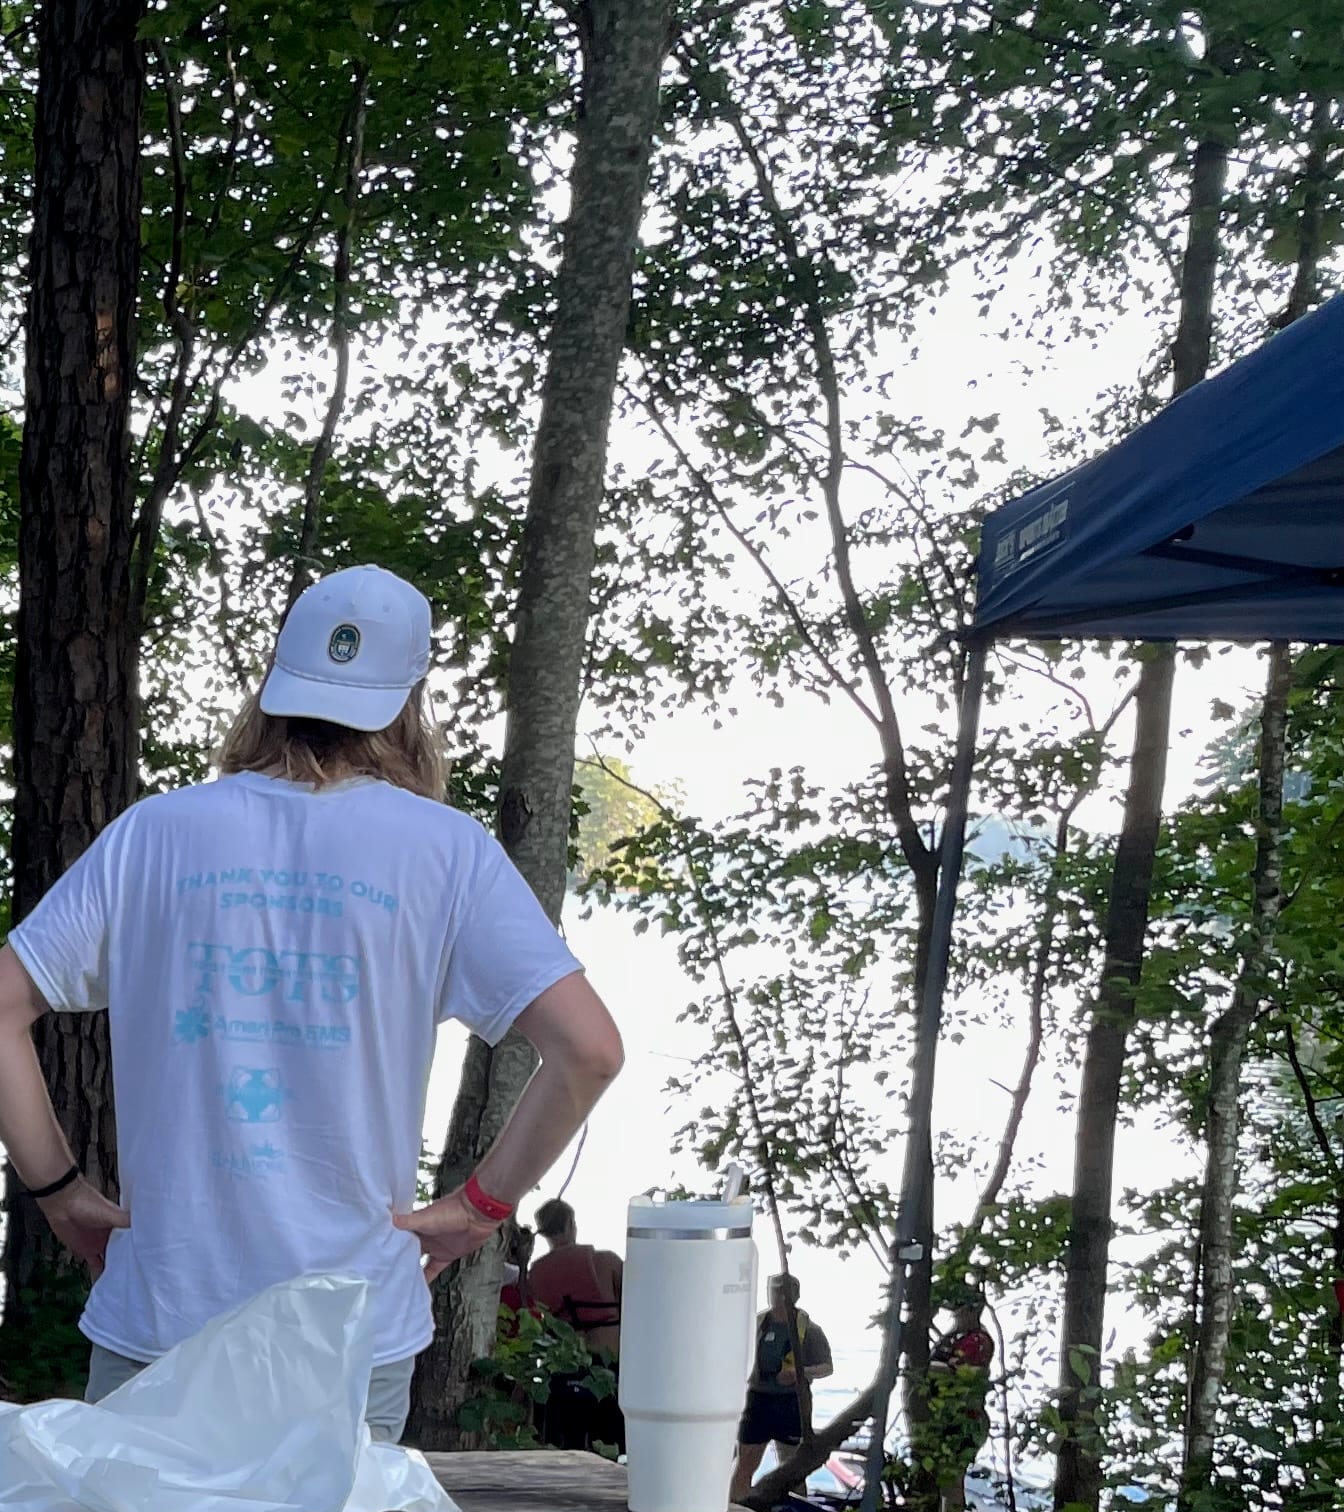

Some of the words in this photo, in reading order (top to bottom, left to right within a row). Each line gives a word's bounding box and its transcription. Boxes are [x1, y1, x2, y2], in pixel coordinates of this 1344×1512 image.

[176, 868, 251, 896] THANK
[259, 869, 308, 887] YOU
[314, 872, 345, 891] TO
[350, 880, 399, 912] OUR
[219, 892, 345, 917] SPONSORS
